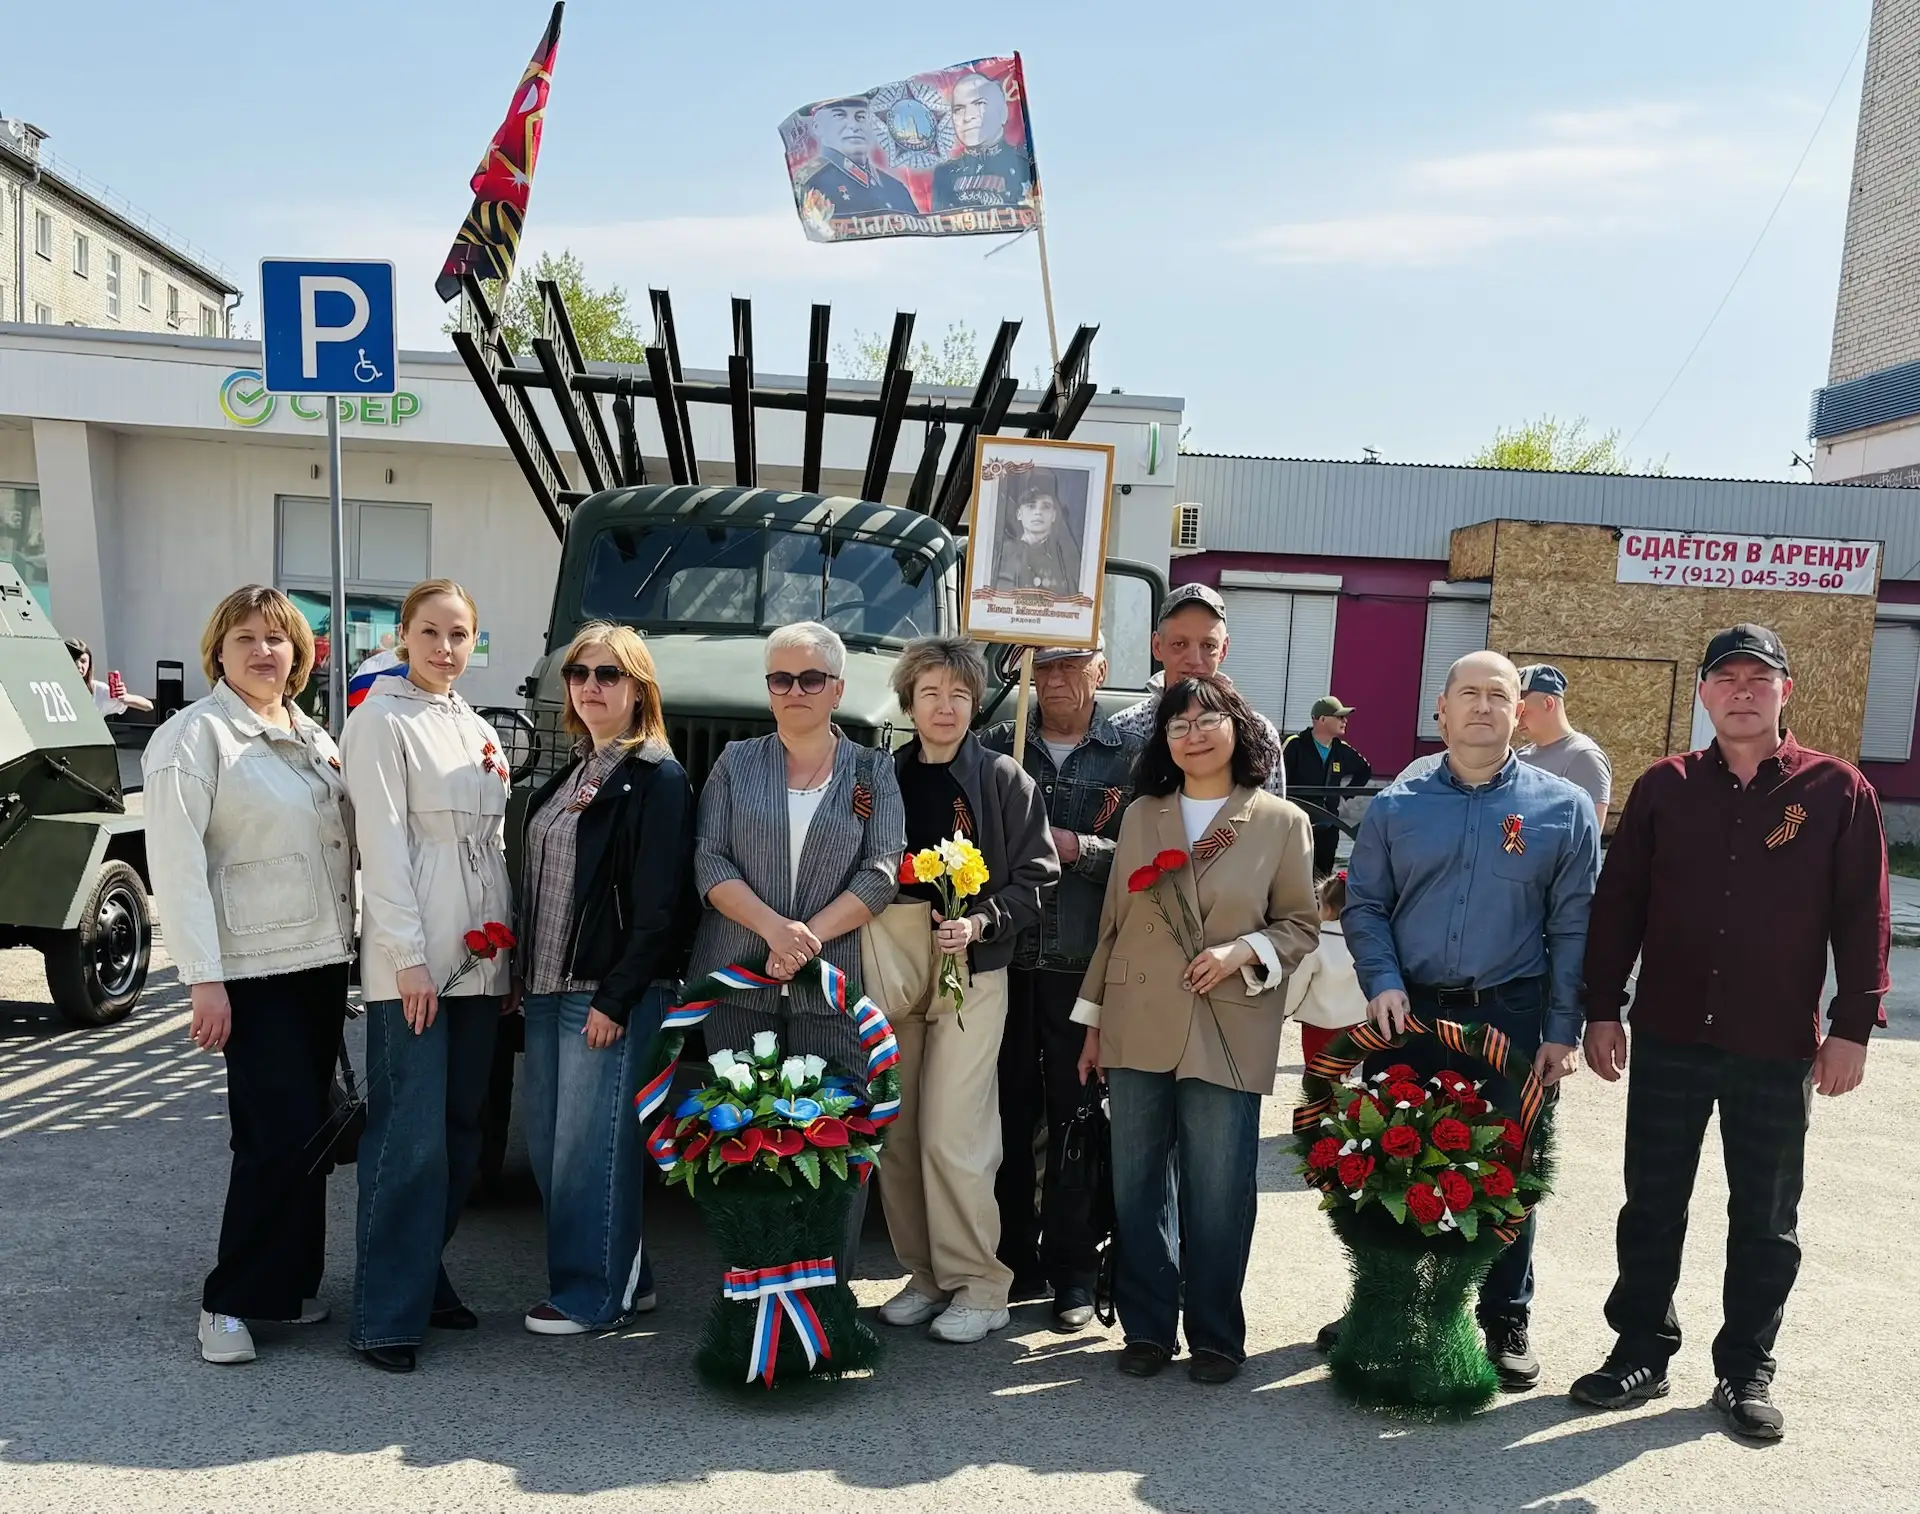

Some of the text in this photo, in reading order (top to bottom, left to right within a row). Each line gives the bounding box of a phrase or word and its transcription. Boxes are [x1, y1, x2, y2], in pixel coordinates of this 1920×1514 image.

[299, 275, 371, 379] P
[1626, 534, 1870, 572] СДАЁТСЯ В АРЕНДУ
[1649, 565, 1844, 590] +7 (912) 045-39-60
[29, 681, 78, 723] 228
